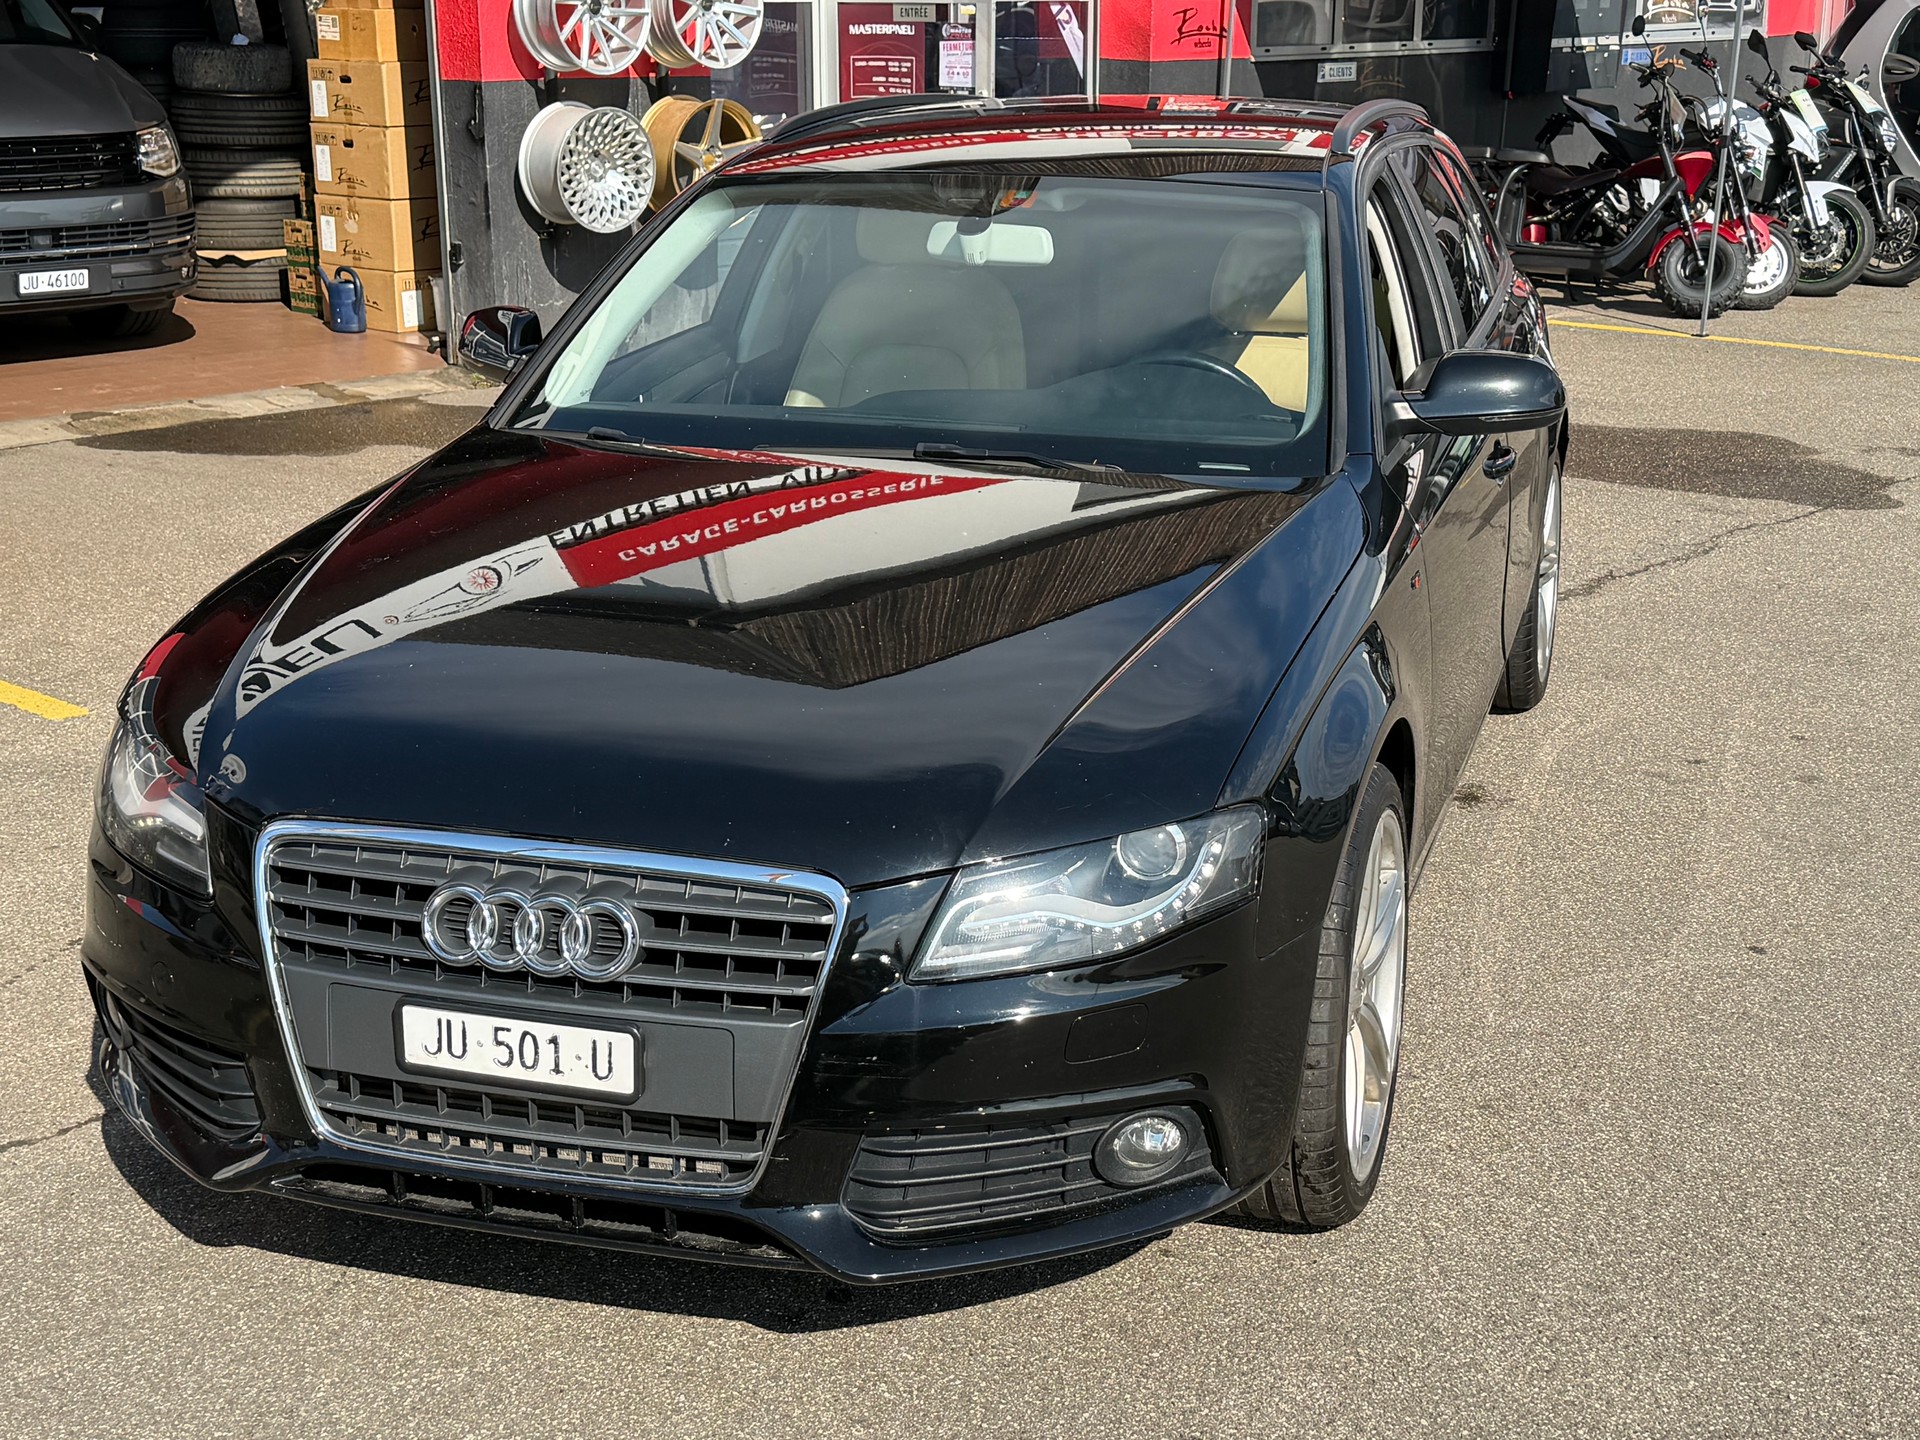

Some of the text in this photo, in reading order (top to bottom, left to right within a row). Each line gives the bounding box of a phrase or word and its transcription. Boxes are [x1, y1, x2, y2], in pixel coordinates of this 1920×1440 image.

[900, 5, 928, 18] ENTRÉE
[849, 24, 915, 35] MASTERPNEU
[1329, 66, 1352, 78] CLIENTS
[24, 272, 85, 290] JU 46100
[422, 1017, 614, 1082] JU 501 U
